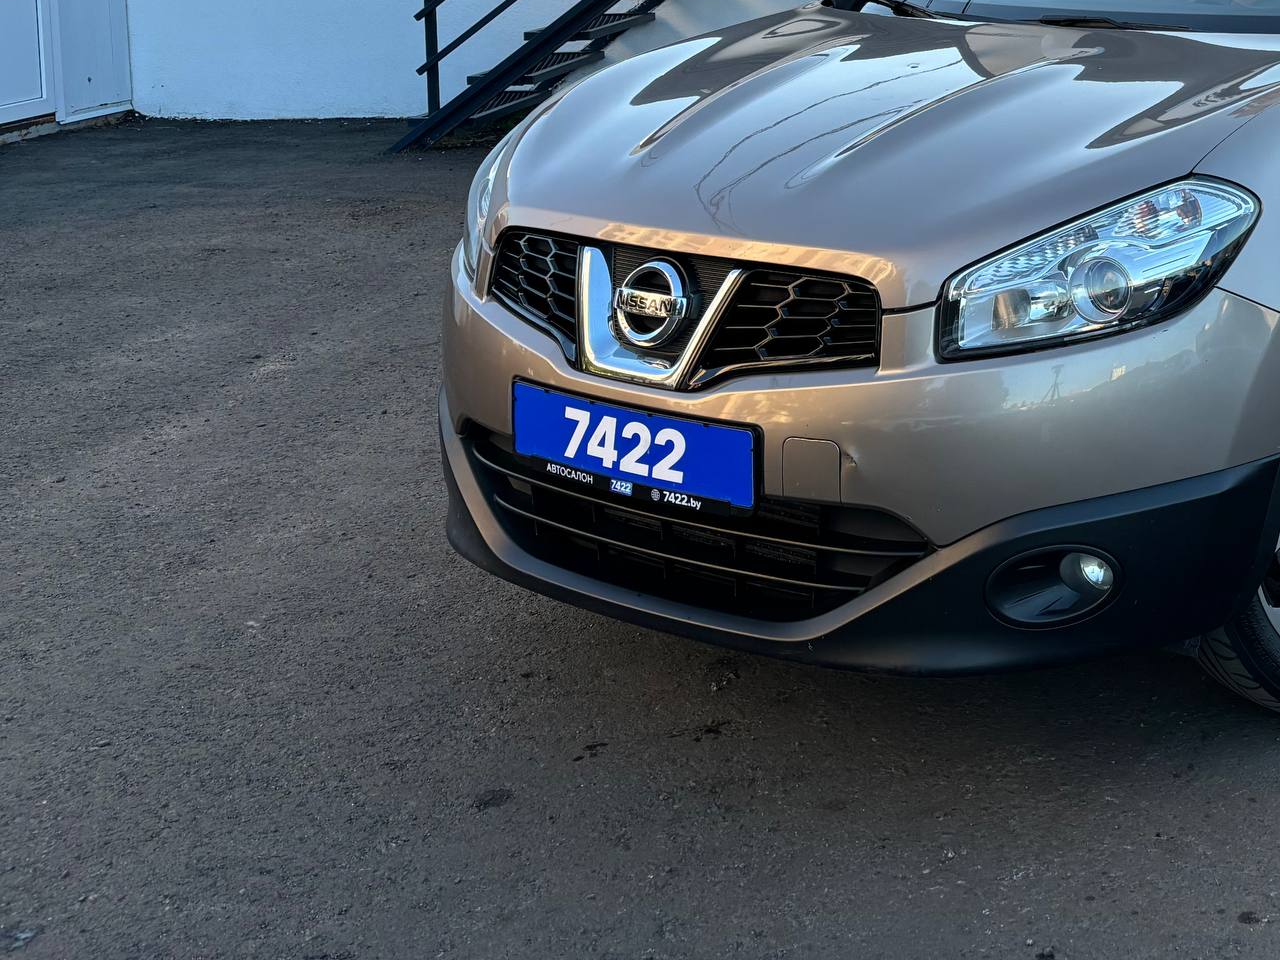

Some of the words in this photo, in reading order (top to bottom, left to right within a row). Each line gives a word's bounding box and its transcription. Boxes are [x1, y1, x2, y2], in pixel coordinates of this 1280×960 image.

[616, 290, 674, 315] NISSAN
[564, 406, 687, 484] 7422
[546, 462, 594, 485] АВТОСАЛОН
[610, 478, 632, 493] 7422
[662, 490, 702, 510] 7422.by
